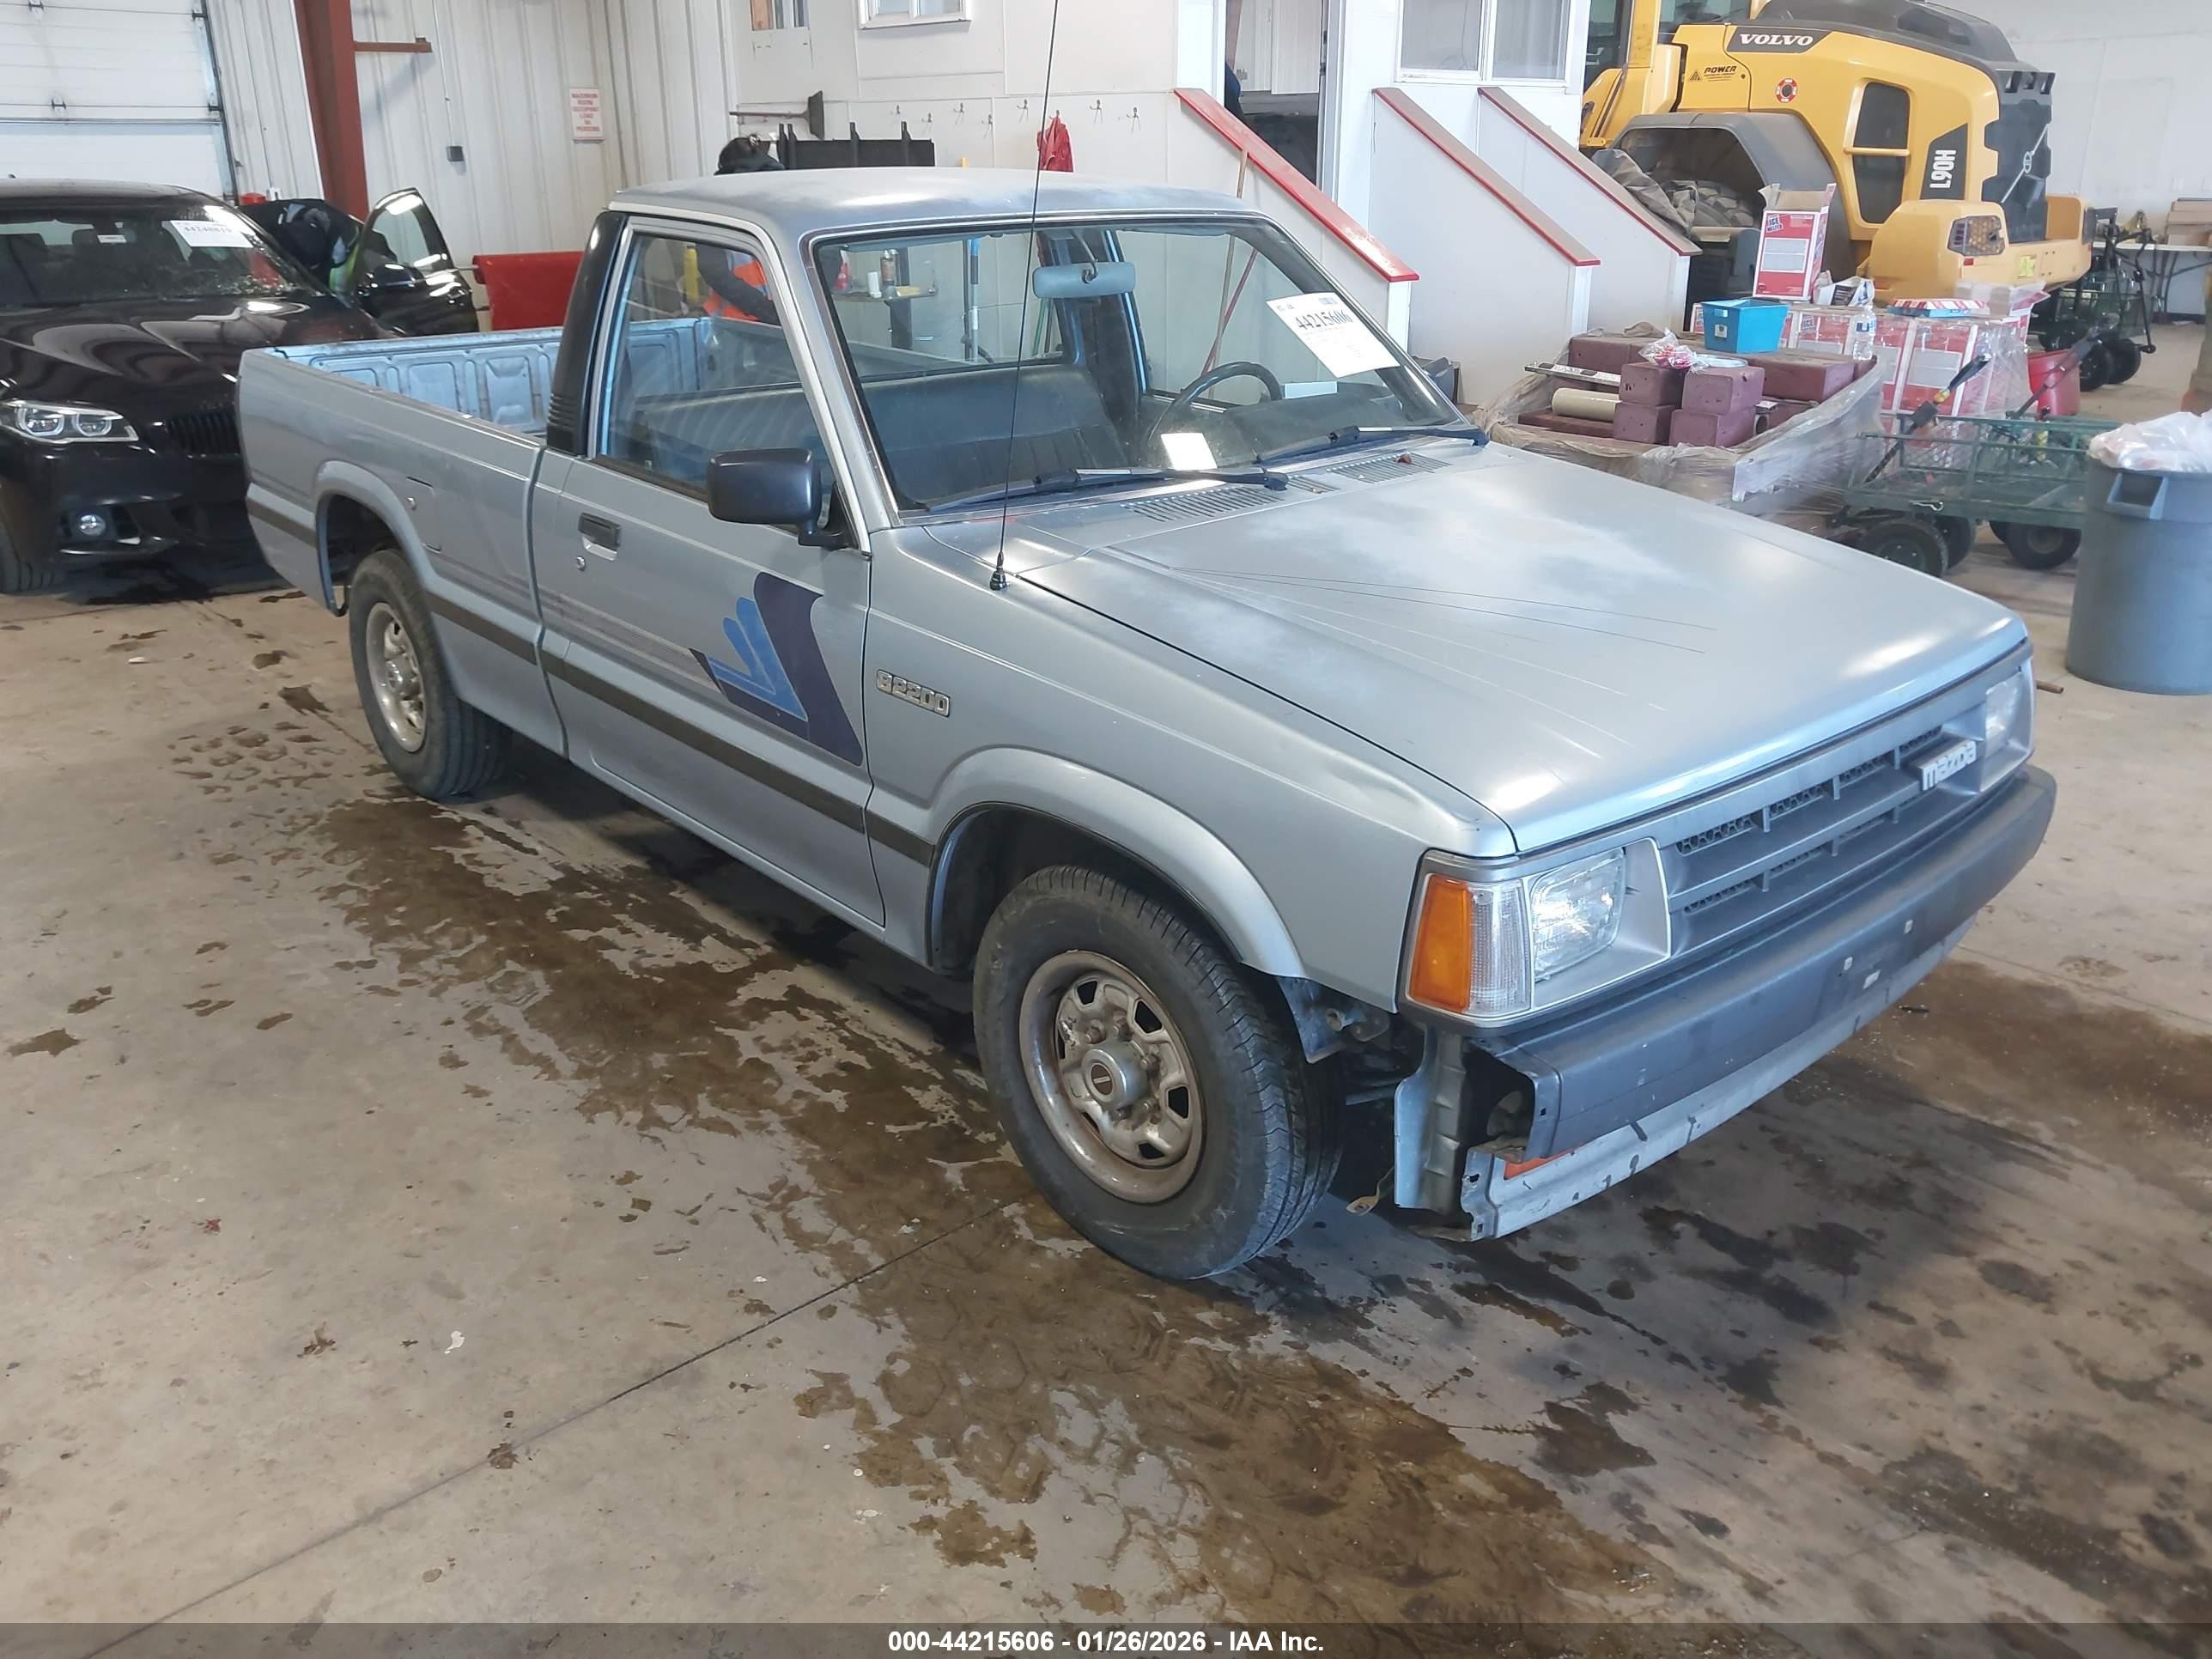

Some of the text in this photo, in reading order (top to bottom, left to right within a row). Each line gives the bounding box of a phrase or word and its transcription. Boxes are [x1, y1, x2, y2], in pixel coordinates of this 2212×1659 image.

[1740, 33, 1814, 46] VOLVO
[1704, 65, 1737, 74] POWER
[1929, 149, 1956, 189] L90H
[1295, 309, 1353, 331] 44215606
[1923, 740, 1977, 791] mazda
